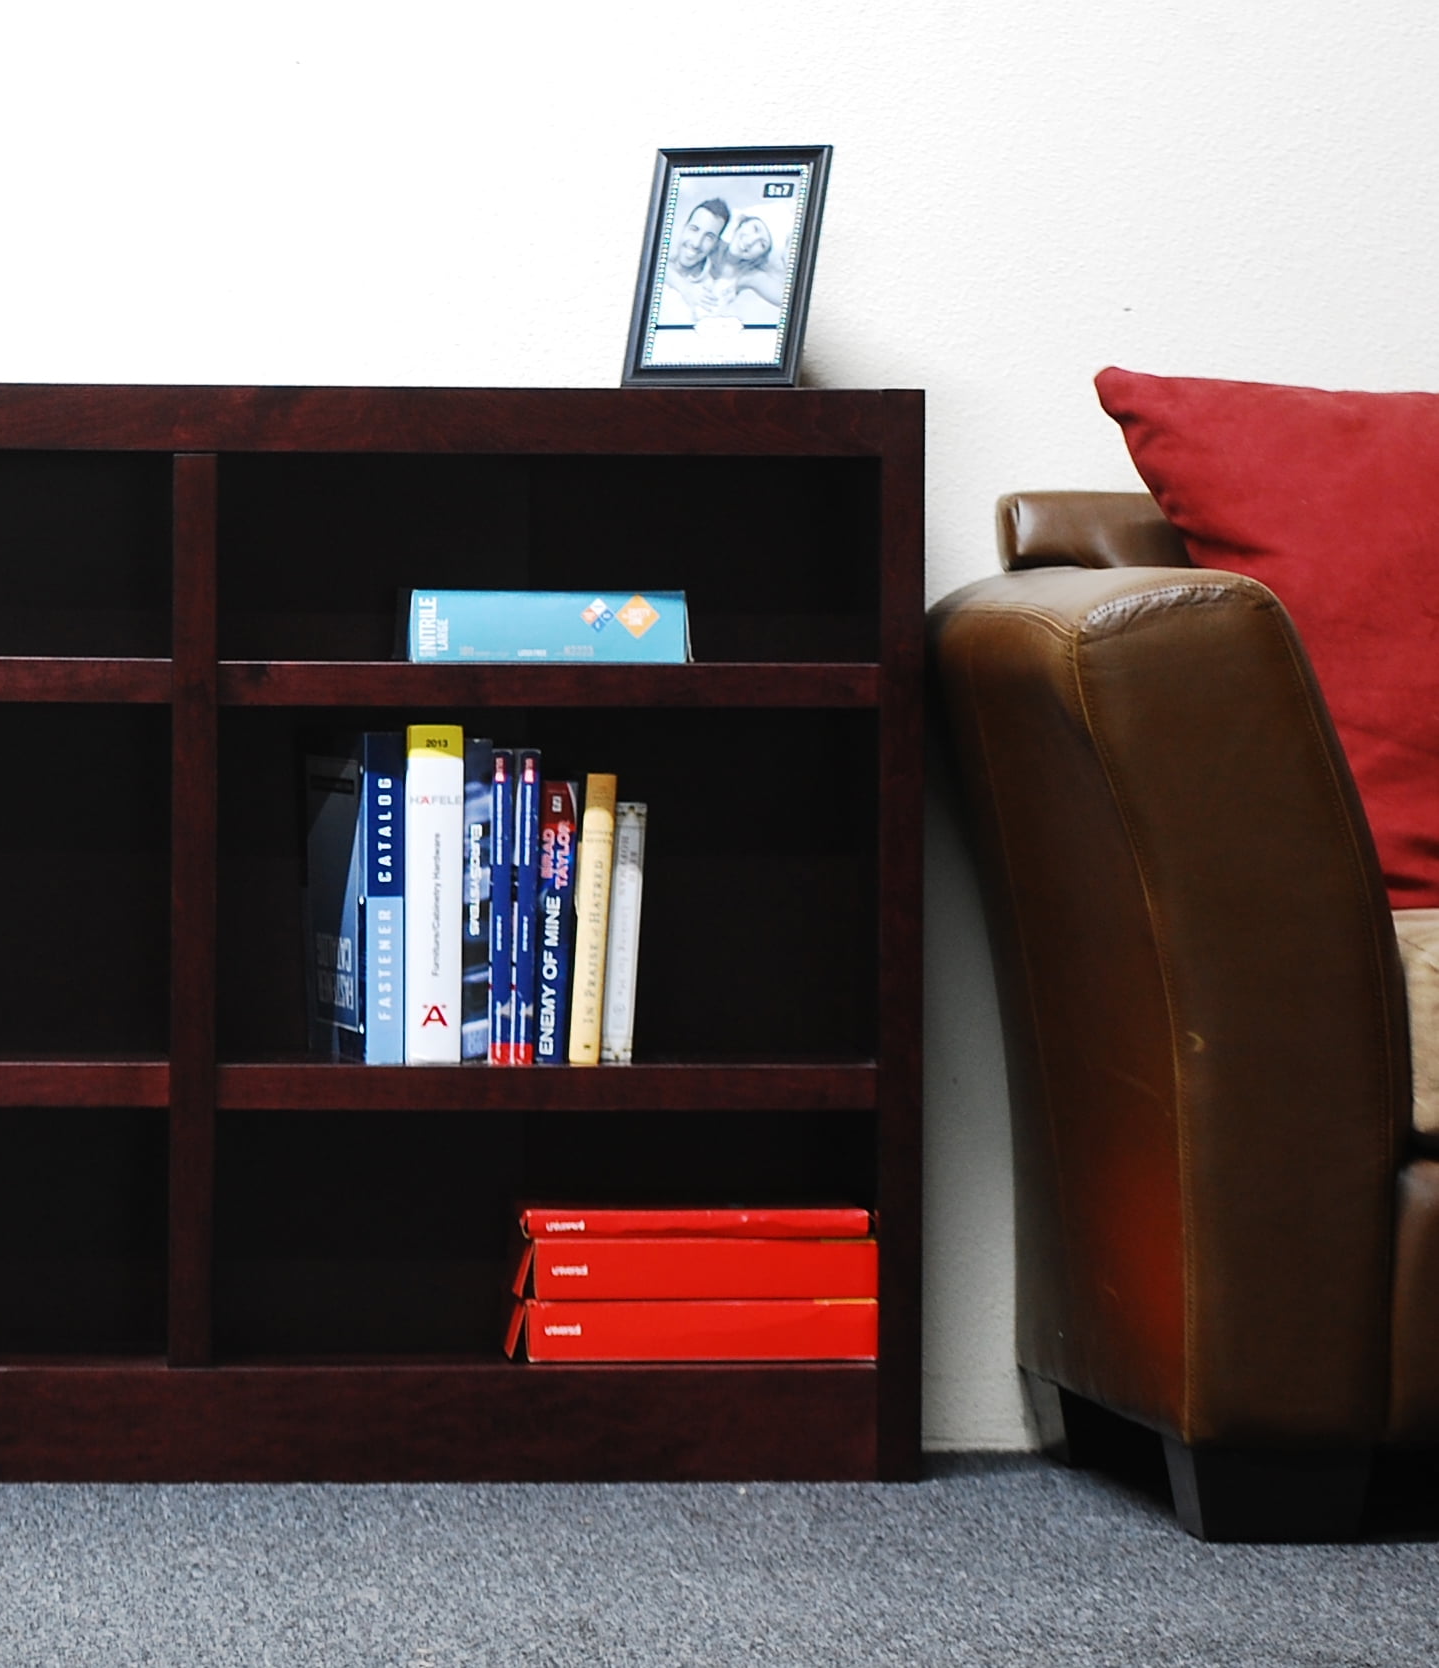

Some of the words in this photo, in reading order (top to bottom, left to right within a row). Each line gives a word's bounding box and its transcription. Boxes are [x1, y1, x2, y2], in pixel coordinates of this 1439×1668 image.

[425, 738, 449, 749] 2013
[377, 777, 393, 884] CATALOG
[433, 832, 442, 881] Hardware
[541, 827, 556, 880] BRAD
[554, 820, 571, 891] TAYLOR
[544, 896, 562, 947] MINE
[378, 908, 392, 1022] FASTENER
[542, 950, 558, 981] OF
[538, 983, 557, 1056] ENEMY
